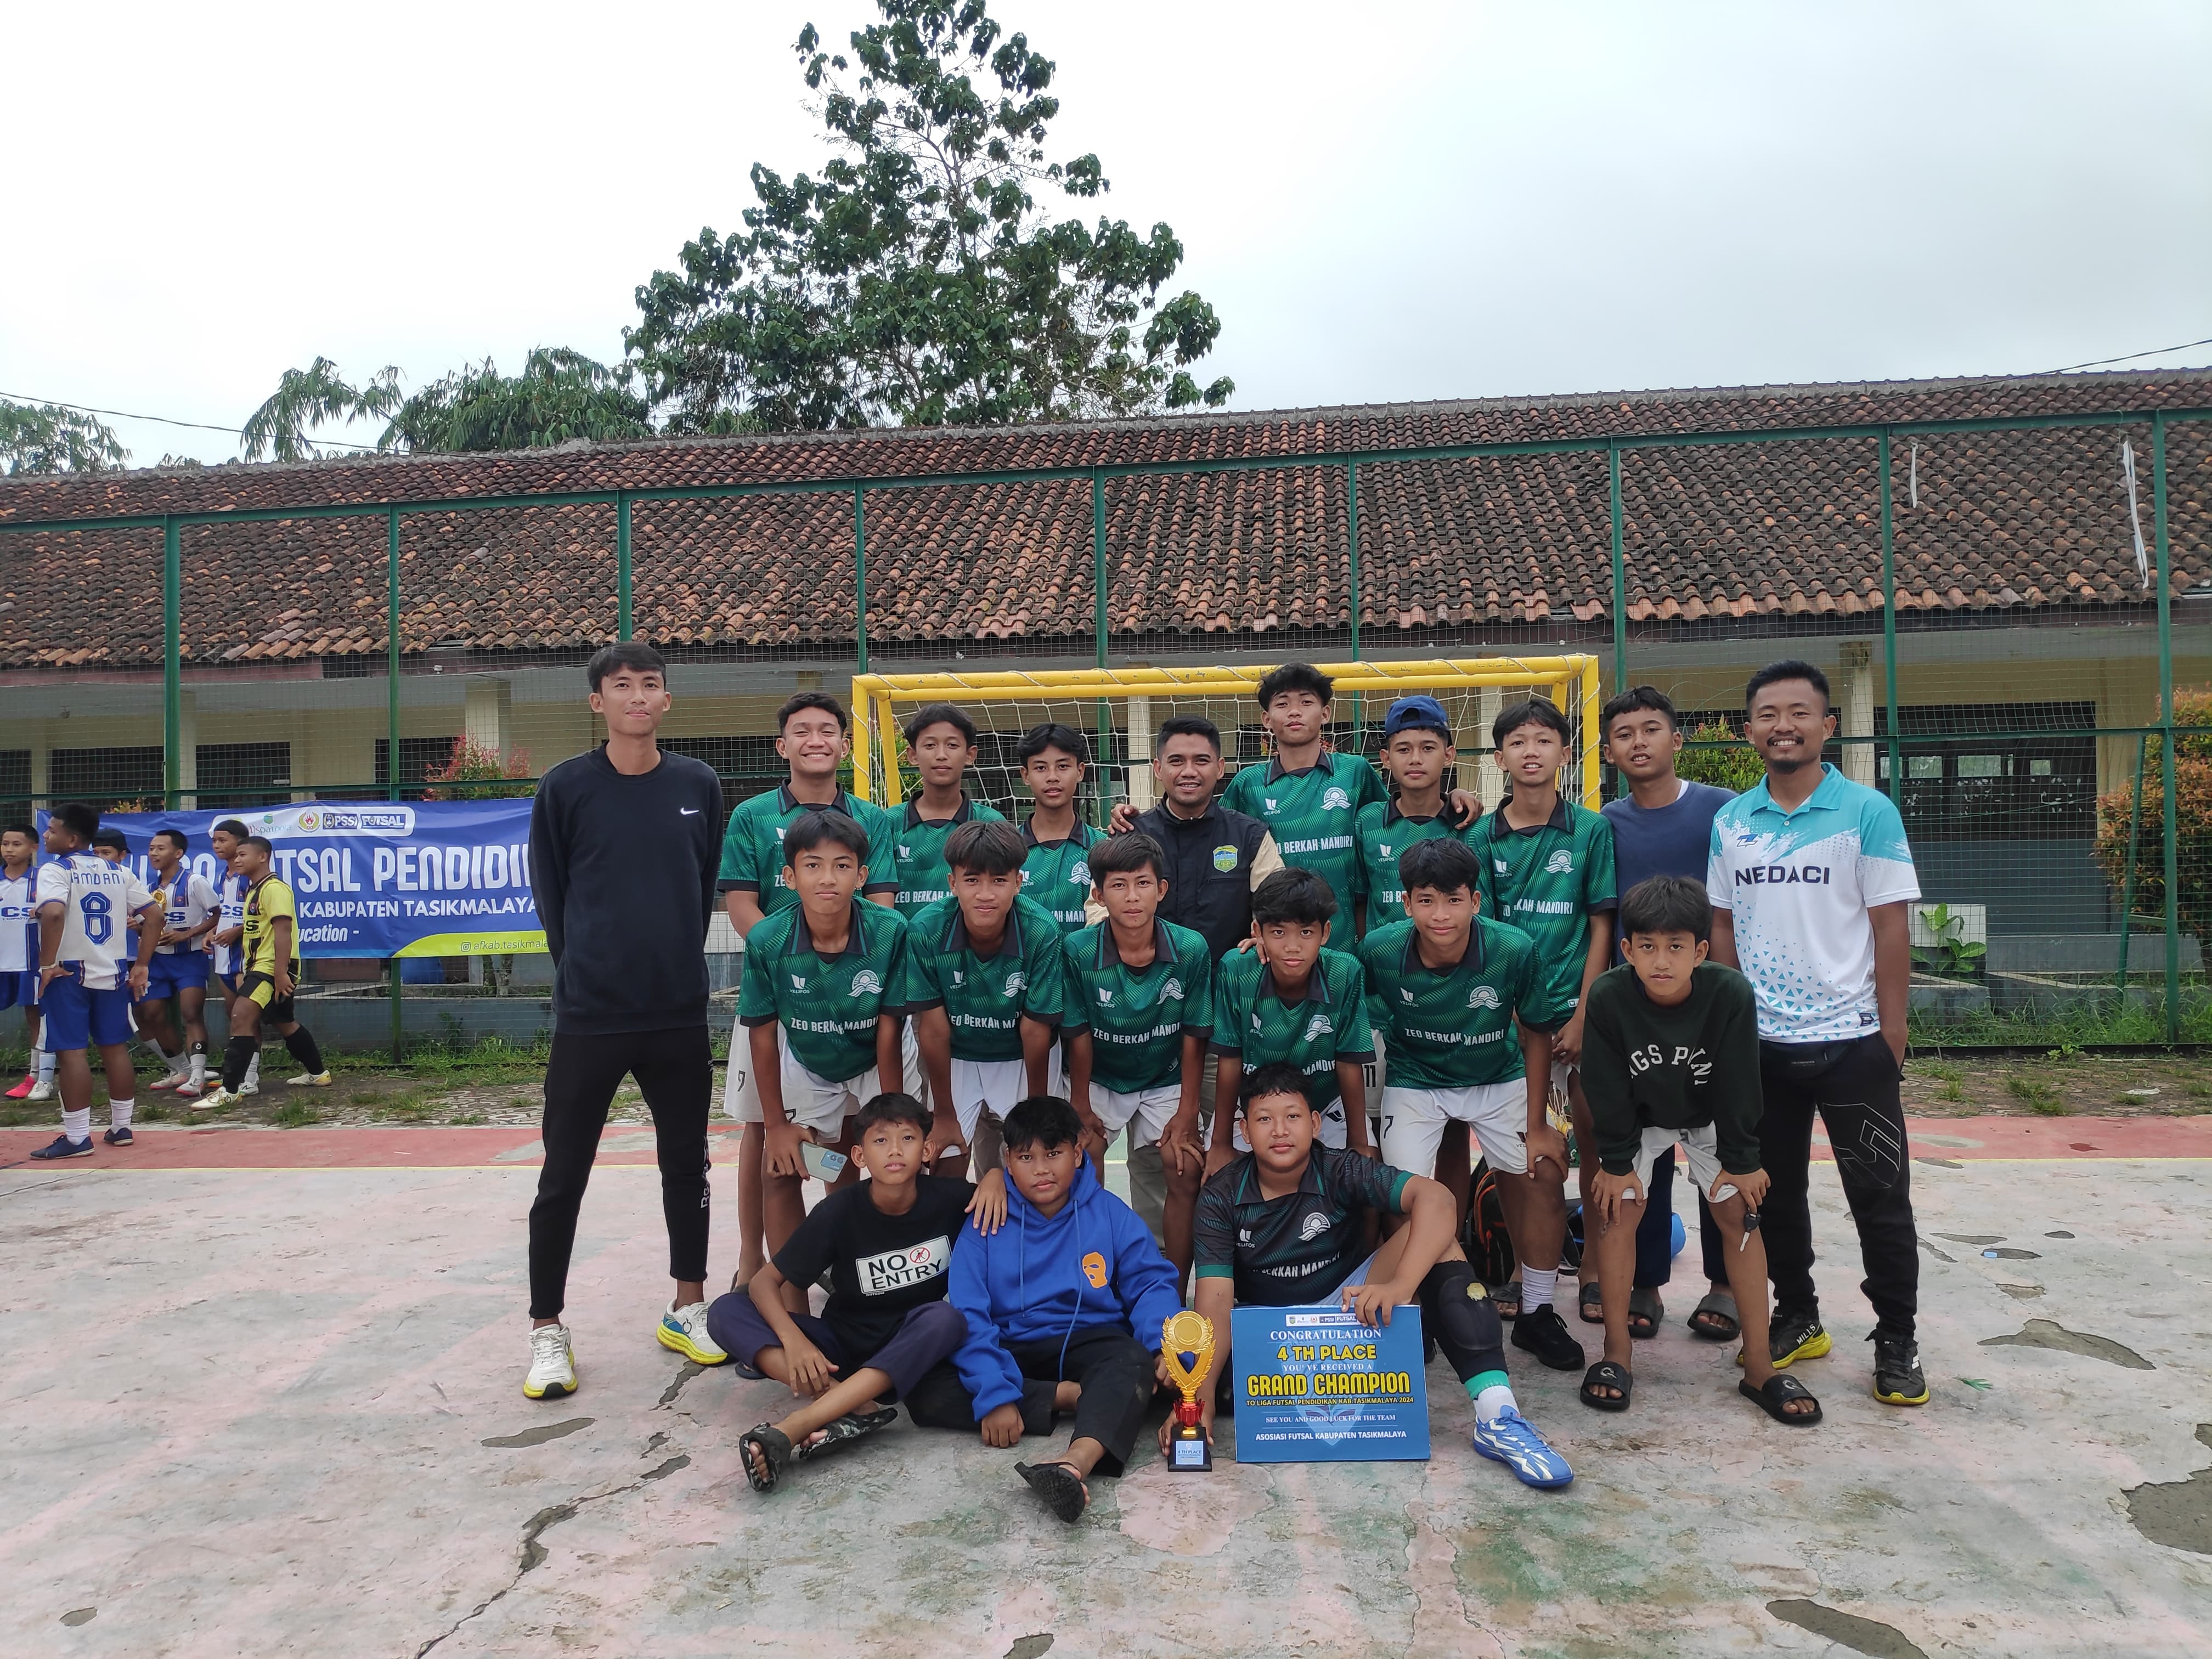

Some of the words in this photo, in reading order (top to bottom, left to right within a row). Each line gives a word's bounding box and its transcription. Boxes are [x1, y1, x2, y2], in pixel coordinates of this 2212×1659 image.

[335, 815, 358, 827] PSSI
[363, 814, 404, 828] FUTSAL
[1284, 839, 1318, 854] BERKAH
[1321, 835, 1353, 851] MANDIRI
[269, 847, 361, 893] TSAL
[374, 844, 531, 892] PENDIDI
[1735, 865, 1830, 887] NEDACI
[1382, 891, 1393, 903] ZEO
[300, 900, 399, 918] KABUPATEN
[1536, 900, 1573, 915] MANDIRI
[80, 891, 114, 946] 8
[298, 924, 348, 943] ucation
[791, 1017, 808, 1030] ZEO
[964, 1013, 1000, 1029] BERKAH
[1093, 1028, 1109, 1041] ZEO
[1113, 1031, 1150, 1044] BERKAH
[1404, 1028, 1423, 1039] ZEO
[1425, 1031, 1463, 1043] BERKAH
[1463, 1029, 1504, 1046] MANDIRI
[737, 1069, 746, 1092] 7
[1364, 1064, 1376, 1088] 11
[1384, 1115, 1394, 1139] 7
[868, 1254, 907, 1277] NO
[871, 1259, 942, 1290] ENTRY
[1270, 1329, 1382, 1341] CONGRATULATION
[1796, 1323, 1816, 1345] MILLS
[1277, 1346, 1288, 1361] 4
[1292, 1346, 1315, 1361] TH
[1320, 1344, 1377, 1361] PLACE
[1321, 1363, 1364, 1372] RECEIVED
[1246, 1374, 1308, 1397] GRAND
[1313, 1372, 1412, 1396] CHAMPION
[1255, 1432, 1287, 1441] ASOSIASI
[1288, 1432, 1314, 1441] FUTSAL
[1315, 1431, 1357, 1440] KABUPATEN
[1358, 1430, 1407, 1439] TASIKMALAYA
